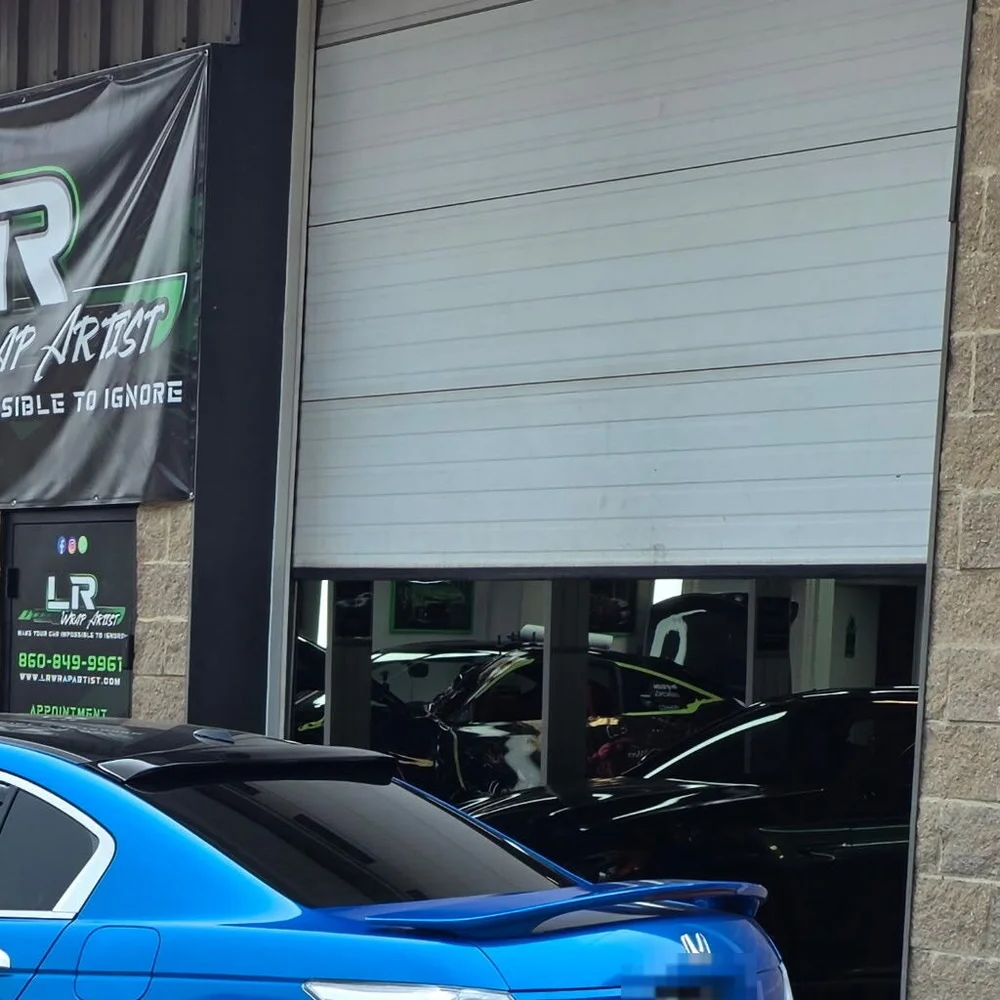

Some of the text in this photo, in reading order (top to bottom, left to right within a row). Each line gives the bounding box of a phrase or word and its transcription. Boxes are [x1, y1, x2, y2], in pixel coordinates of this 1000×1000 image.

[34, 303, 165, 382] ARTIST
[73, 390, 96, 414] TO
[104, 380, 183, 409] IGNORE
[47, 575, 96, 610] LR
[60, 610, 120, 630] WRAP ARTIST
[18, 652, 123, 672] 860-849-9961
[30, 704, 108, 718] APPOINTMENT
